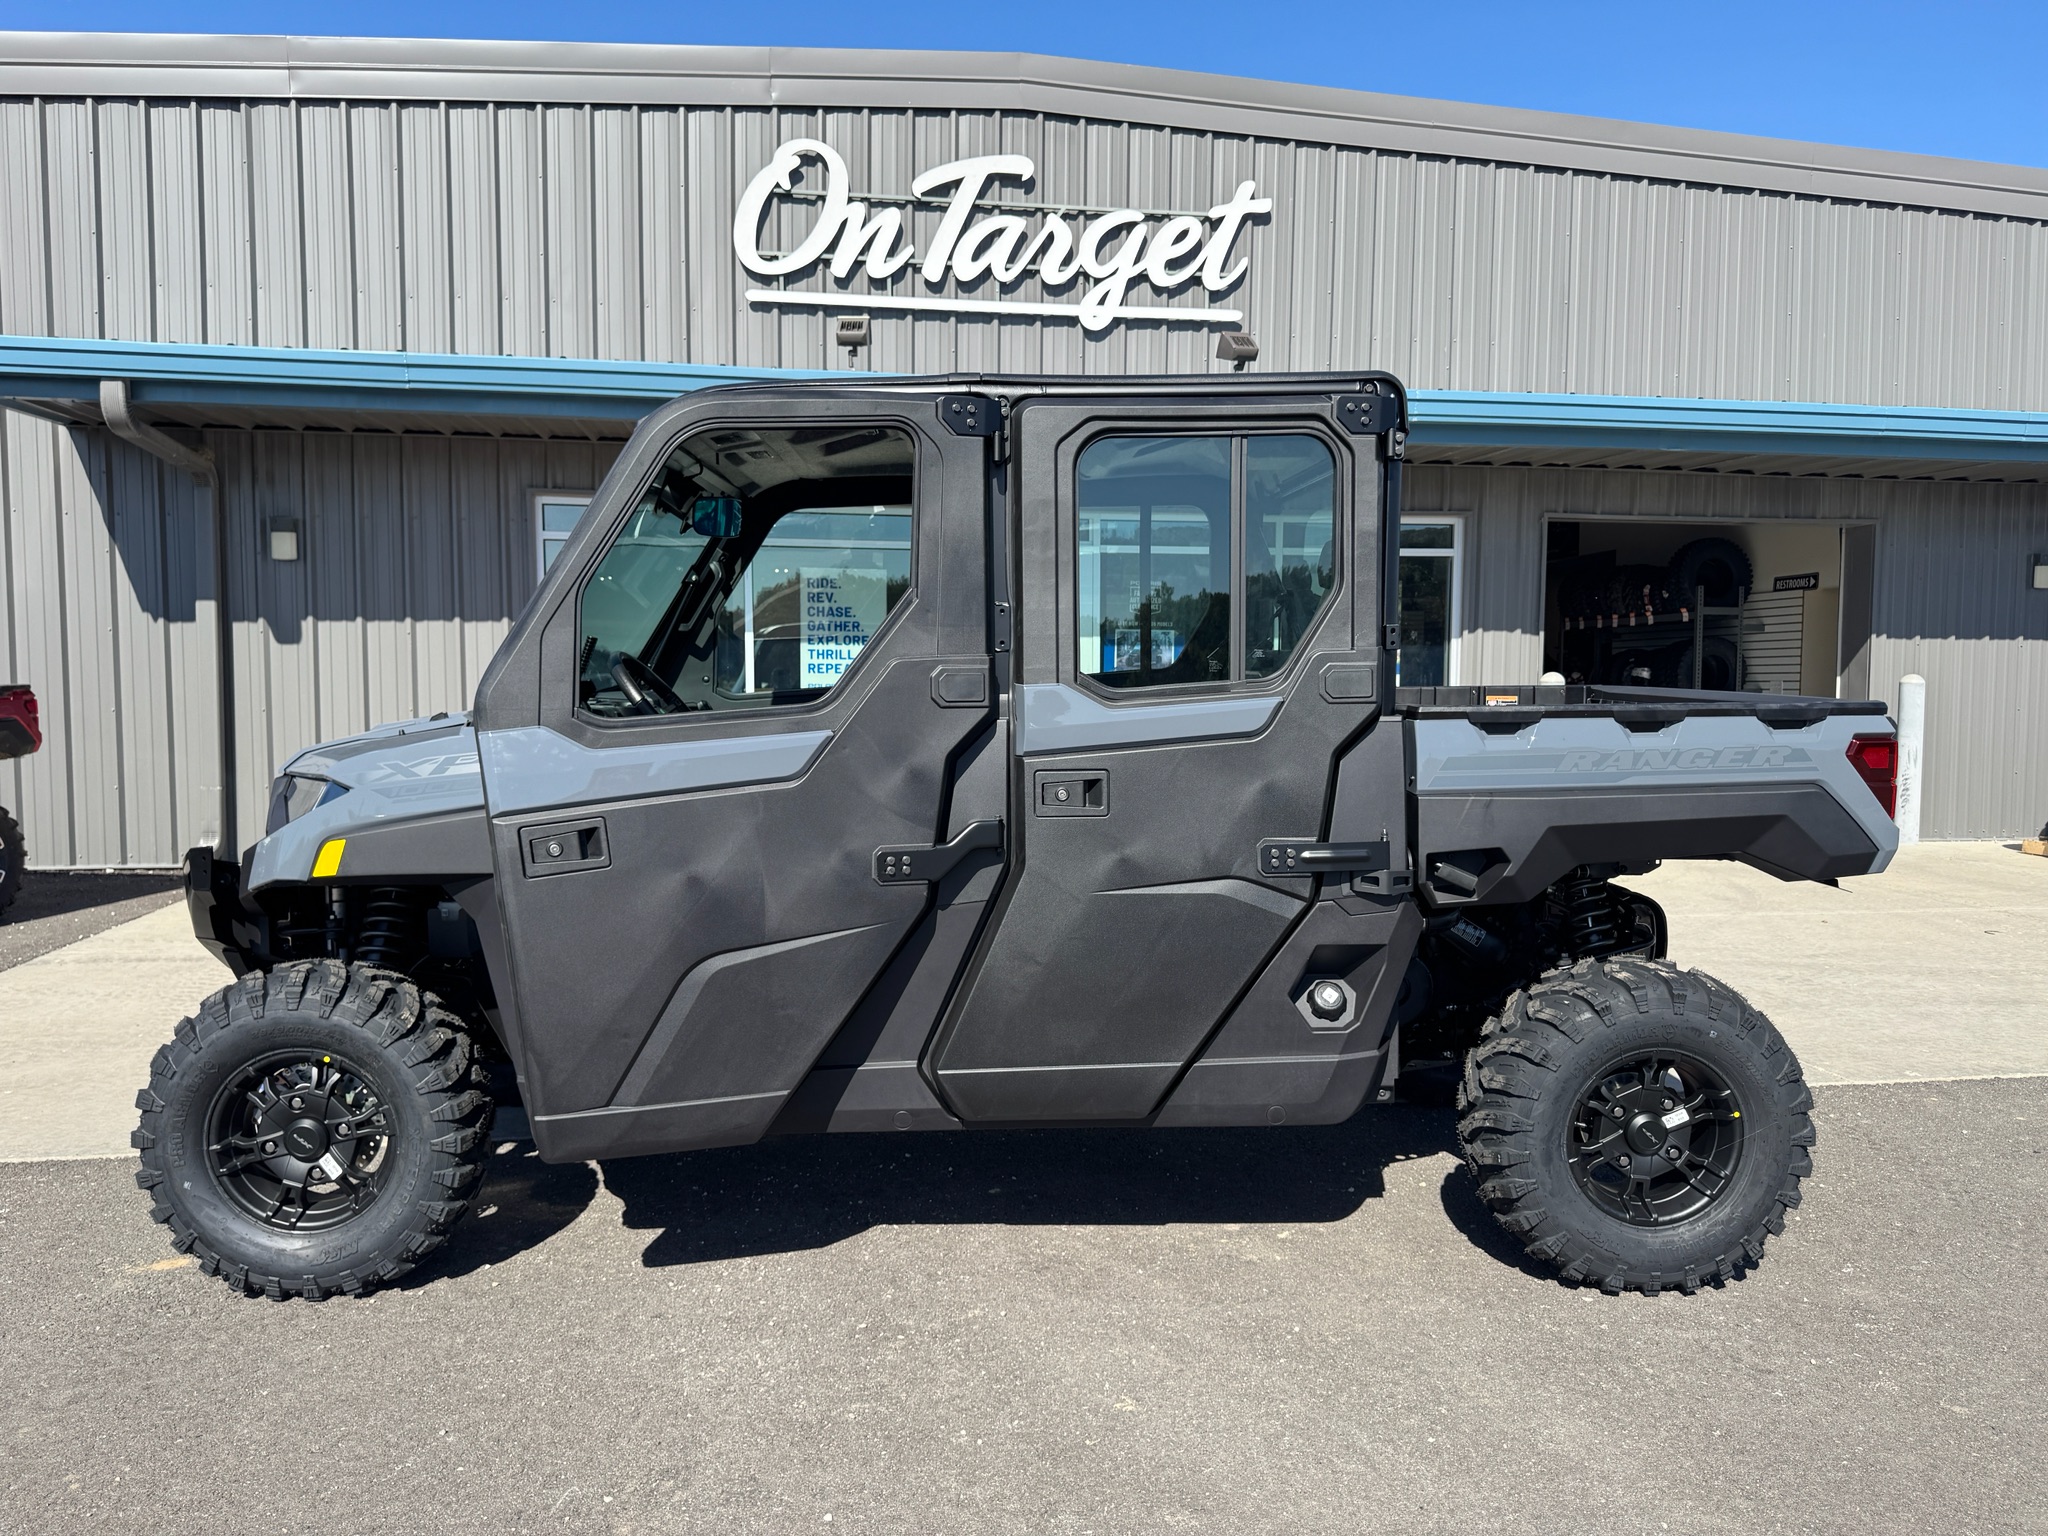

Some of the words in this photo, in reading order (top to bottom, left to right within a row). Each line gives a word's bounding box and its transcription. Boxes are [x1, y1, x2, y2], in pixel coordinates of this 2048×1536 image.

[807, 578, 842, 589] RIDE.
[1776, 577, 1809, 590] RESTROOMS
[807, 592, 837, 603] REV.
[807, 606, 856, 618] CHASE.
[807, 620, 865, 632] GATHER.
[1554, 745, 1793, 772] RANGER
[371, 752, 480, 783] XP
